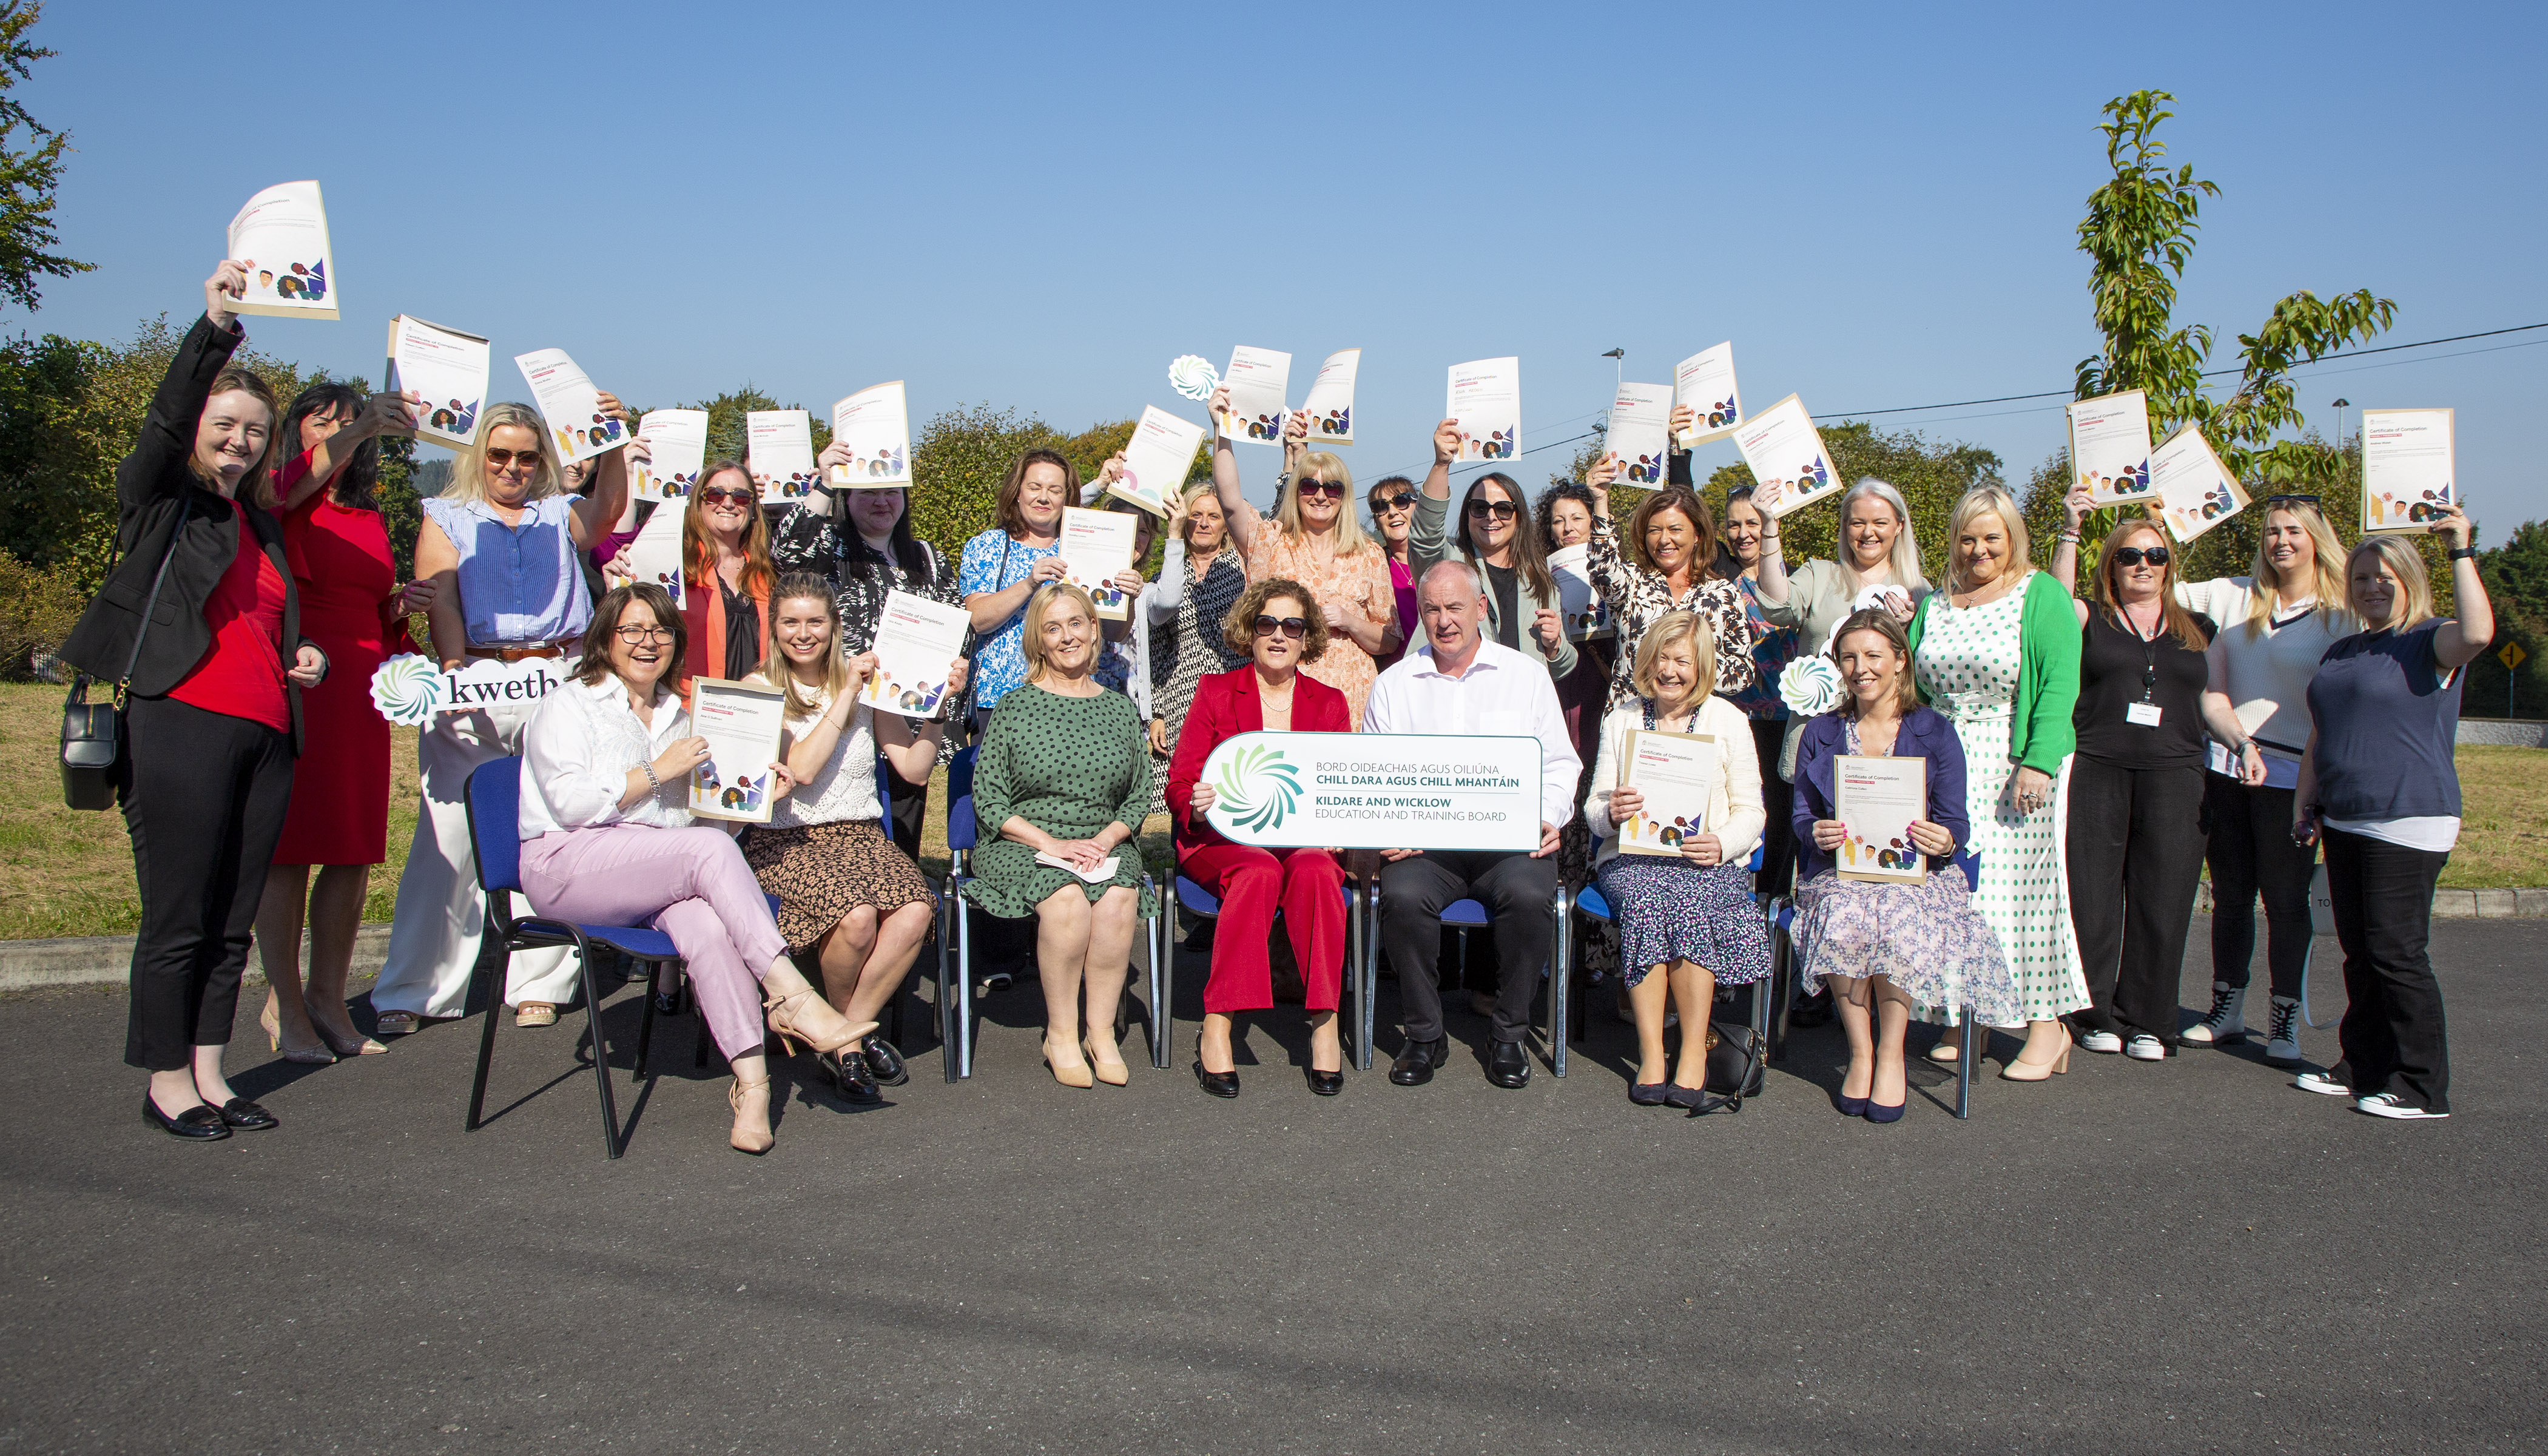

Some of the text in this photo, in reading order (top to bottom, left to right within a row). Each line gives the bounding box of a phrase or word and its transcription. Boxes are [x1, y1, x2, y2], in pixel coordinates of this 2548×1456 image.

[257, 198, 290, 208] Completion
[406, 333, 431, 343] Certificate
[437, 342, 465, 351] Completion
[528, 366, 547, 375] Certificate
[1147, 419, 1162, 428] Certificate
[1165, 427, 1183, 437] Completion
[1744, 433, 1761, 444] Certificate
[1765, 419, 1785, 432] Completion
[2165, 449, 2186, 461] Completion
[891, 607, 914, 617] Certificate
[920, 615, 945, 626] Completion
[703, 700, 726, 709] Certificate
[733, 706, 759, 715] Completion
[1316, 762, 1499, 774] BORD OIDEACHAIS AGUS OILIÚNA
[1316, 775, 1519, 787] CHILL DARA AGUS CHILL MHANTÁIN
[1316, 796, 1451, 807] KILDARE AND WICKLOW
[1315, 809, 1506, 821] EDUCATION AND TRAINING BOARD
